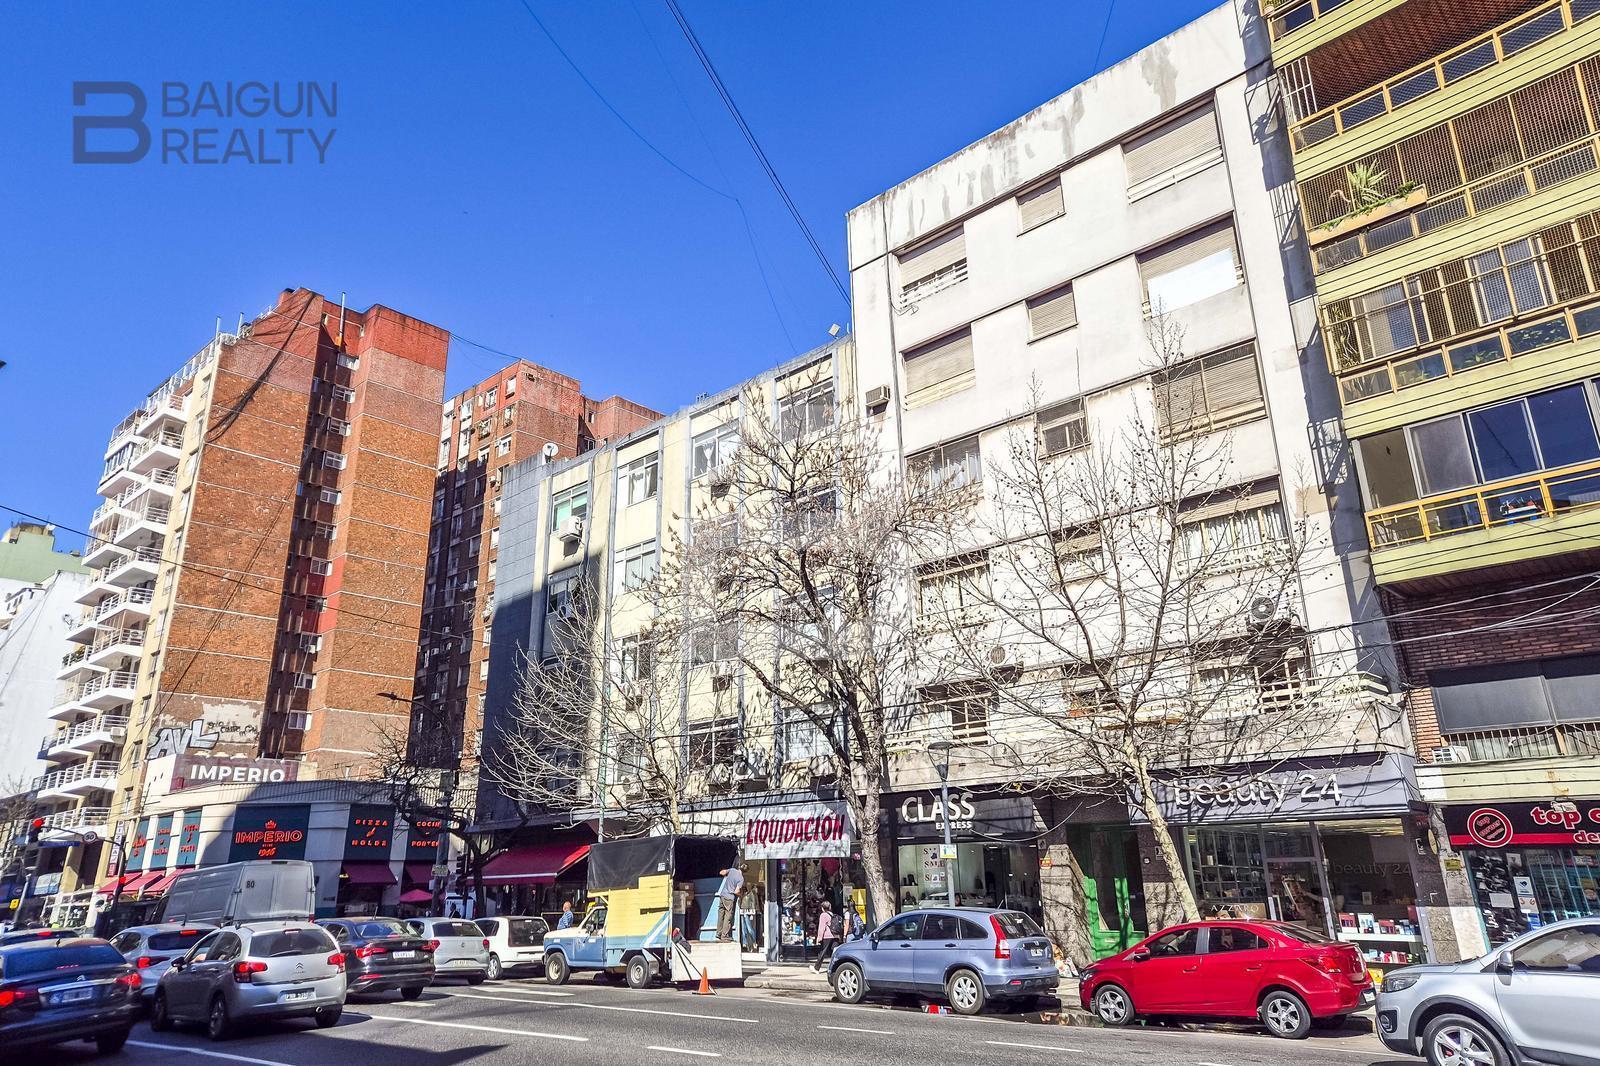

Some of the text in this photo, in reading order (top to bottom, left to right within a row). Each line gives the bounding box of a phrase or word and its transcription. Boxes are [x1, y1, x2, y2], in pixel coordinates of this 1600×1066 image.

[190, 764, 286, 783] IMPERIO
[1173, 773, 1343, 809] beauty 24
[901, 792, 976, 824] CLASS
[935, 820, 973, 831] EXRESS
[1530, 806, 1582, 830] top
[85, 833, 95, 841] 50
[234, 830, 303, 844] IMPERIO
[746, 813, 846, 849] LIQUIDACION
[1573, 830, 1600, 844] de
[1333, 861, 1388, 877] beauty
[246, 880, 256, 889] 80
[1210, 904, 1260, 913] AZZARO
